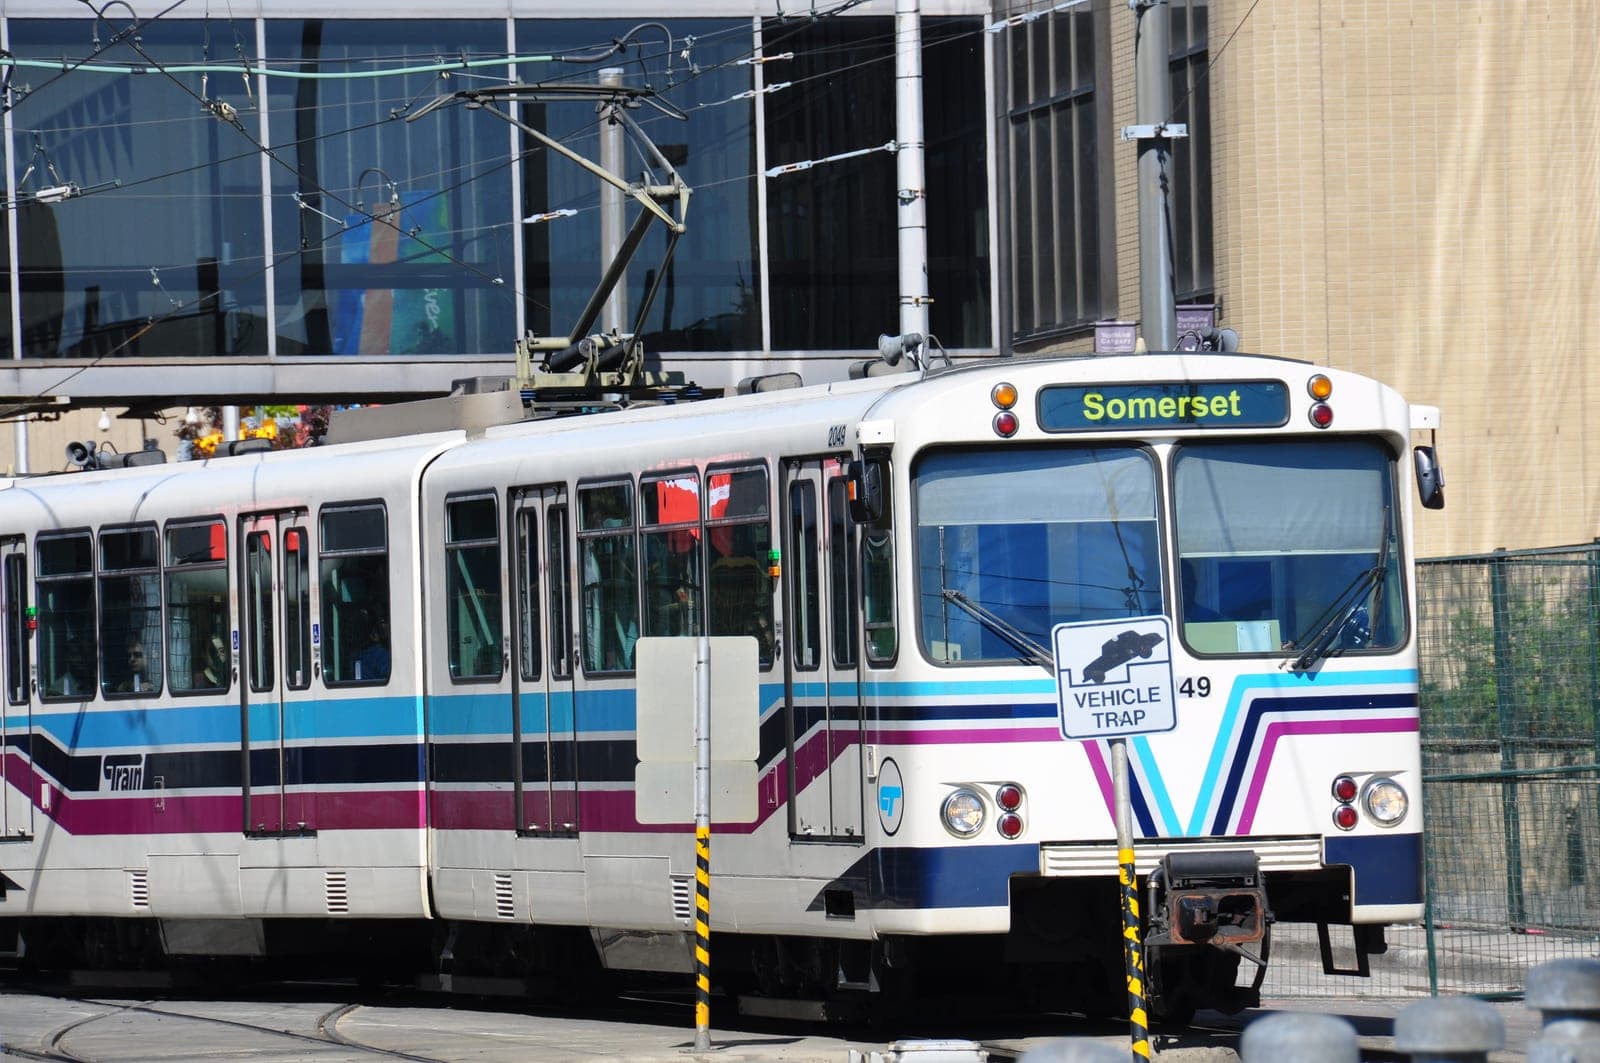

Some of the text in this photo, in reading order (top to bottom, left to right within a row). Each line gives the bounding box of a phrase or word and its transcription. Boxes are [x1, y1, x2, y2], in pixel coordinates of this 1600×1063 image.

[1083, 390, 1241, 420] Somerset
[828, 424, 847, 447] 2049
[1074, 687, 1161, 708] VEHICLE
[1175, 676, 1212, 698] 49
[1092, 710, 1146, 729] TRAP
